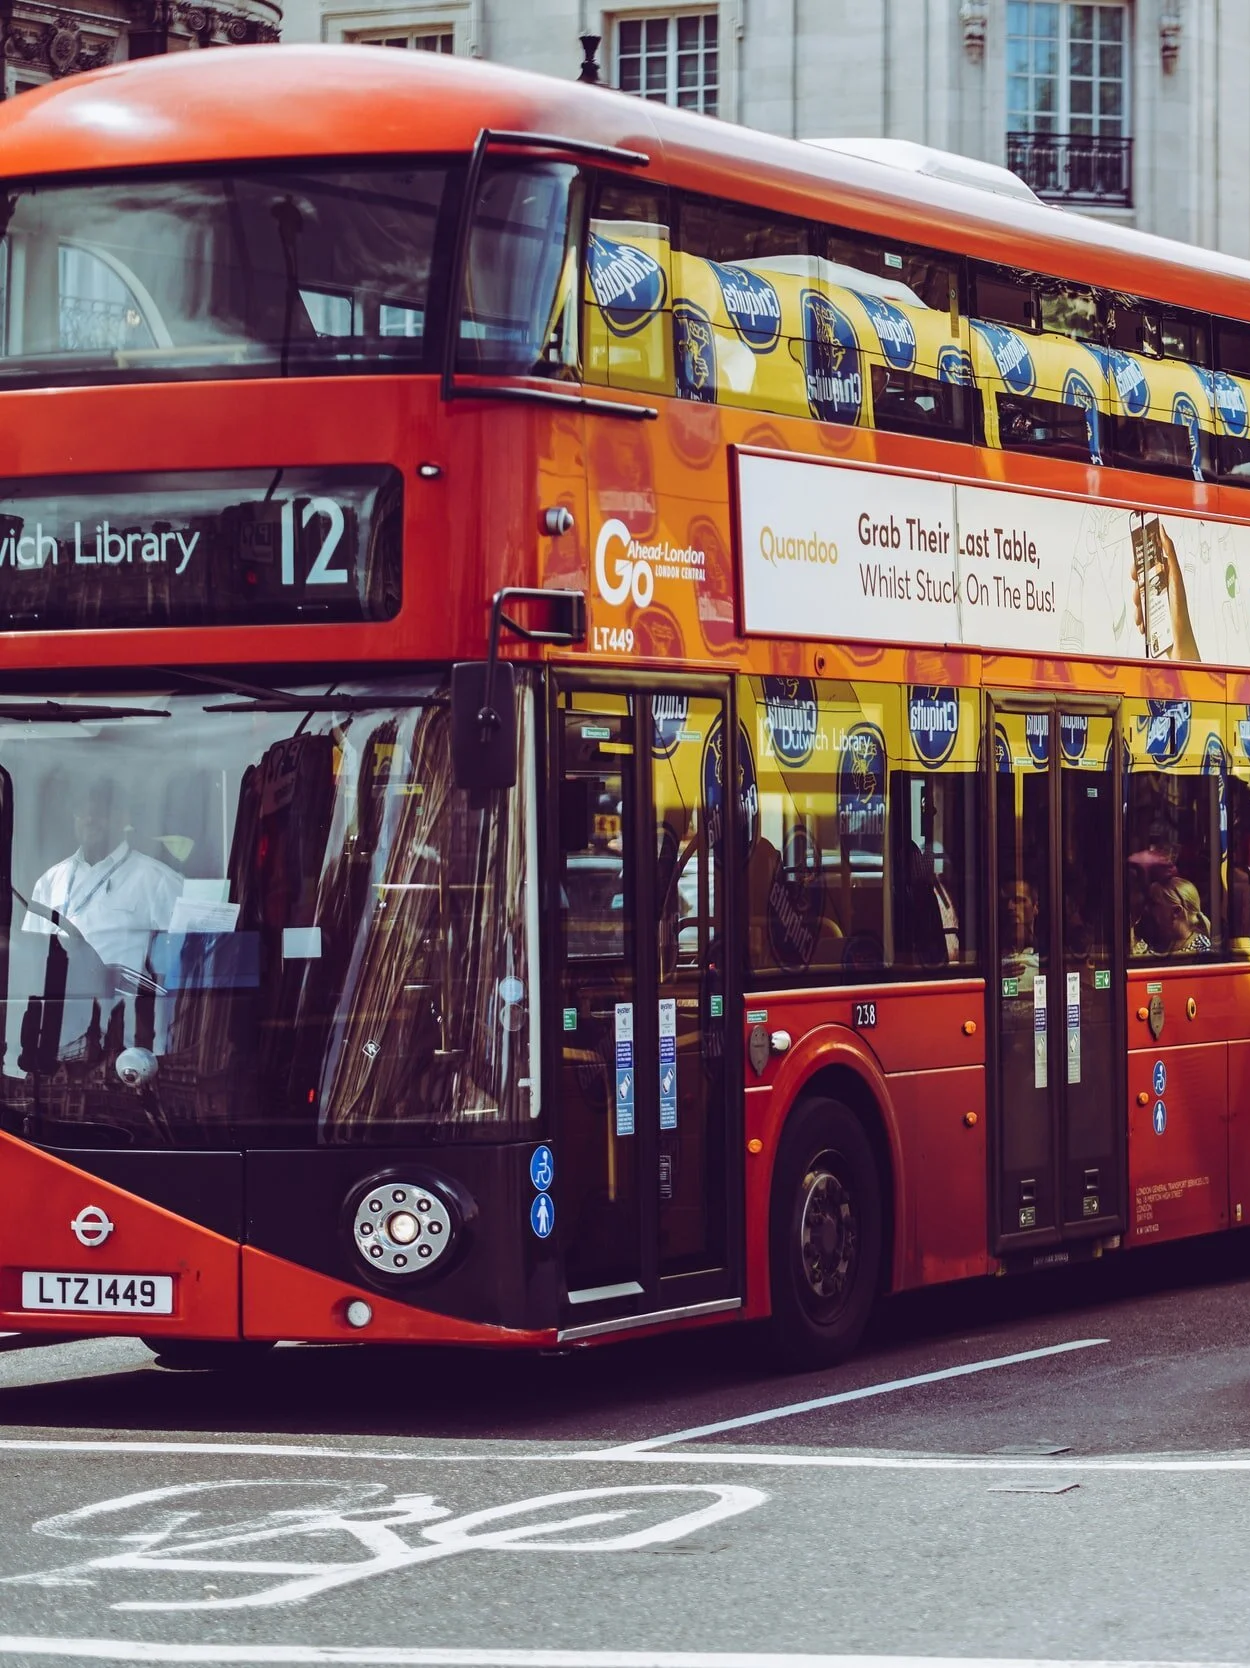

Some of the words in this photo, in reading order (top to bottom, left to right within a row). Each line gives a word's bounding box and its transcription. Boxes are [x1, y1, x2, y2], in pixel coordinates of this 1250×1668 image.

[74, 520, 200, 575] Library
[281, 496, 348, 585] 12
[627, 540, 705, 565] Ahead-London
[759, 525, 838, 568] Quandoo
[858, 512, 901, 549] Grab
[905, 518, 950, 555] Their
[993, 527, 1041, 570] Table,
[595, 518, 654, 608] Go
[655, 564, 680, 578] LONDON
[681, 566, 706, 581] CENTRAL
[859, 562, 912, 601] Whilst
[916, 568, 962, 604] Stuck
[966, 573, 990, 607] On
[993, 575, 1021, 610] The
[1026, 579, 1056, 613] Bus!
[593, 626, 634, 653] LT449
[759, 717, 776, 756] 12
[782, 726, 829, 750] Dulwich
[832, 728, 871, 758] Library
[856, 1004, 876, 1025] 238
[39, 1276, 89, 1305] LTZ
[97, 1278, 156, 1307] 1449
